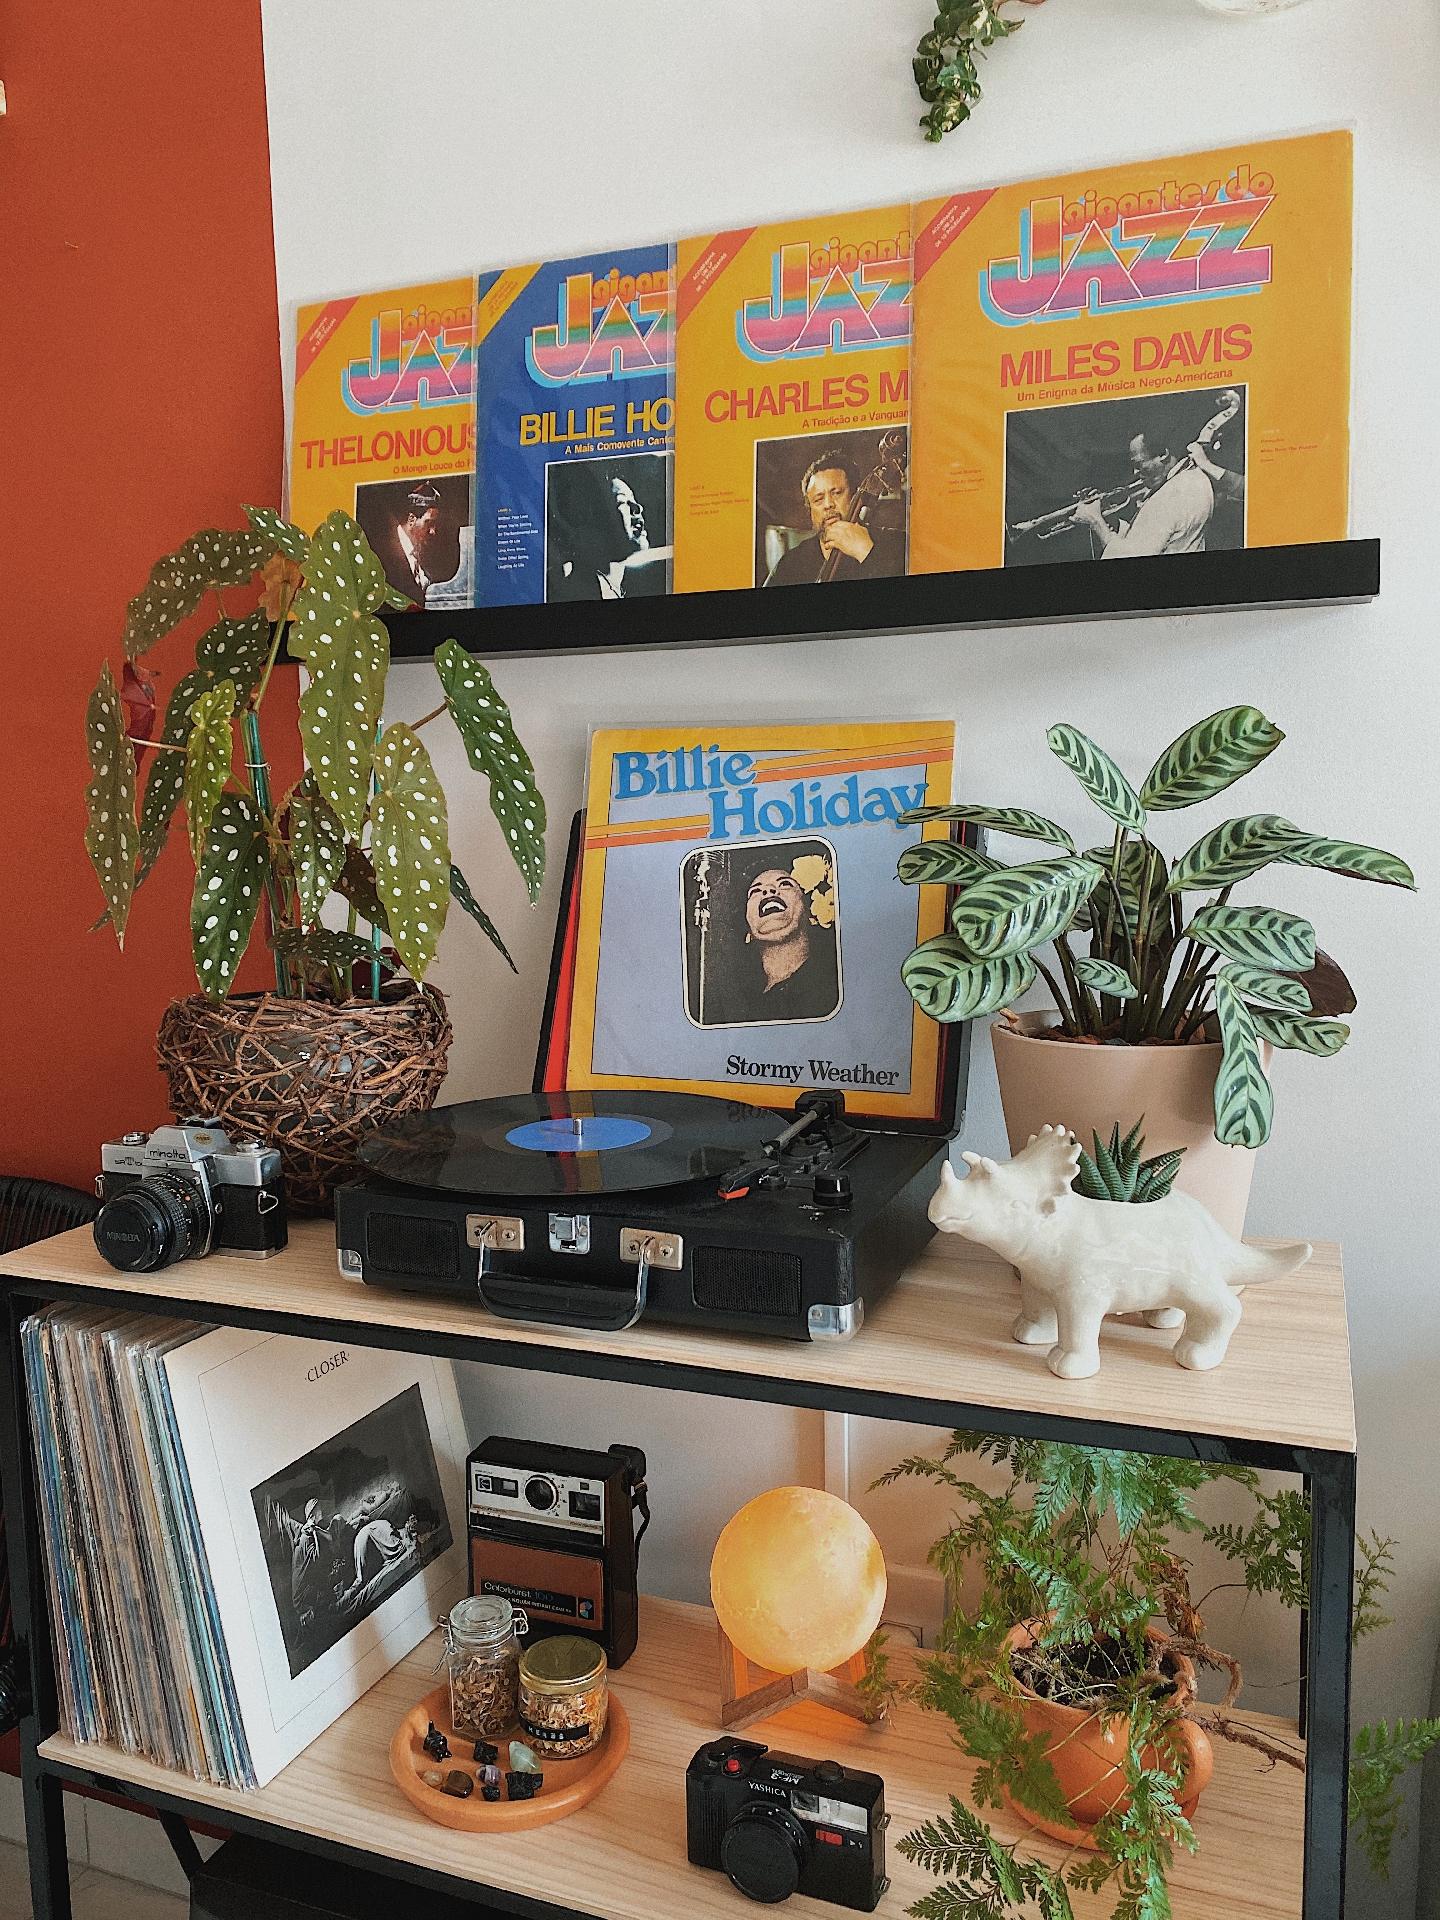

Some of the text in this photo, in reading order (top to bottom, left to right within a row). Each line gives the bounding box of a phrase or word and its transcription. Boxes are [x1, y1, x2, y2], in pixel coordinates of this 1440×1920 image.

[1226, 164, 1275, 200] do
[988, 193, 1277, 318] JAZZ
[1000, 323, 1253, 387] MILES DAVIS
[704, 374, 870, 423] CHARLES
[1017, 369, 1234, 401] Um Enigma da Música Negro-Americana
[519, 396, 676, 446] BILLIE HO
[802, 418, 810, 429] A
[812, 414, 850, 428] Tradição
[860, 414, 867, 422] a
[565, 445, 572, 455] A
[574, 442, 595, 454] Mais
[597, 437, 646, 451] Comovente
[393, 465, 401, 474] O
[401, 464, 428, 473] Monge
[429, 462, 453, 471] Louco
[455, 459, 465, 468] do
[613, 744, 757, 799] Billie
[709, 774, 929, 839] Holiday
[727, 1054, 900, 1086] Stormy Weather
[149, 1148, 187, 1160] minolta
[307, 1350, 349, 1382] CLOSER
[748, 1780, 787, 1798] YASHICA
